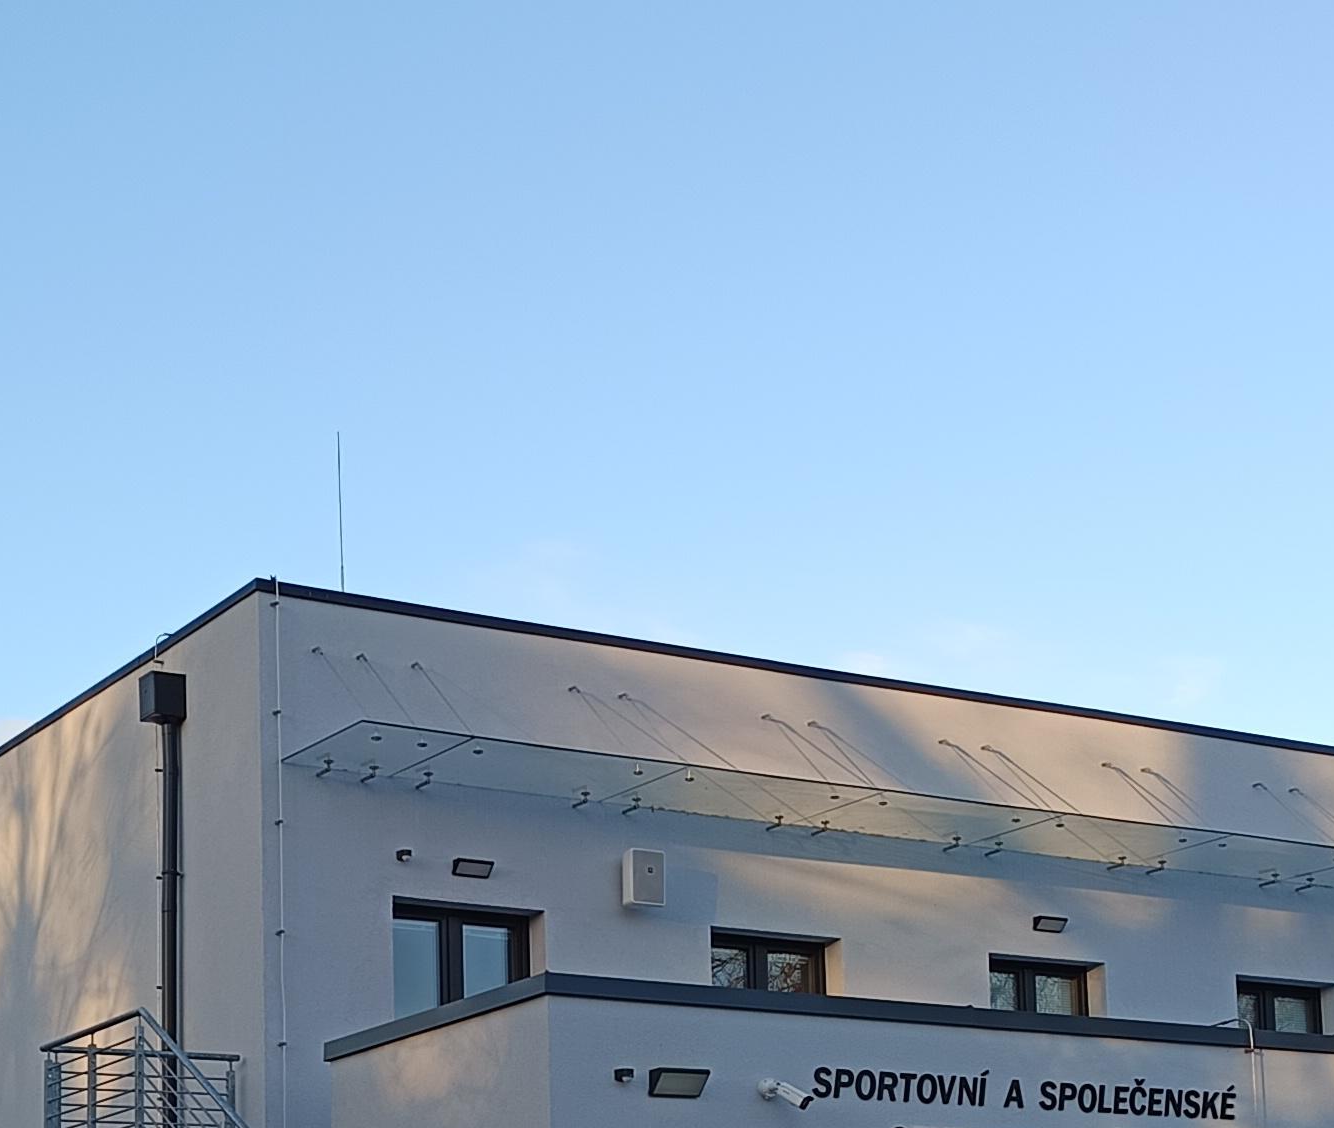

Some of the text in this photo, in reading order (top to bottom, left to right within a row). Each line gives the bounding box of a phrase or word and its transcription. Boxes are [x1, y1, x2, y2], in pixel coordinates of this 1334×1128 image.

[812, 1066, 1236, 1121] SPORTOVNÍ A SPOLEČENSKÉ
